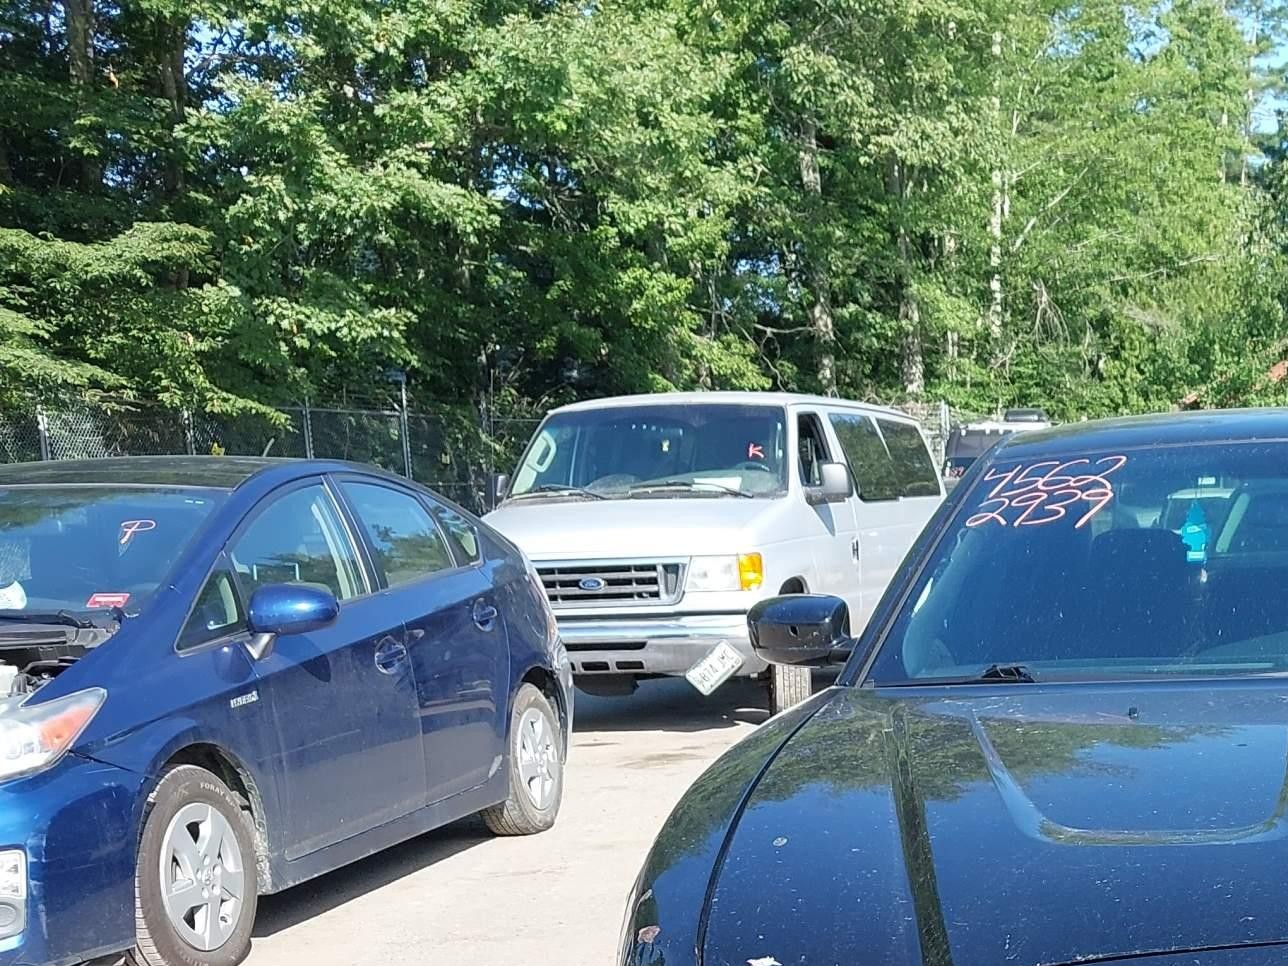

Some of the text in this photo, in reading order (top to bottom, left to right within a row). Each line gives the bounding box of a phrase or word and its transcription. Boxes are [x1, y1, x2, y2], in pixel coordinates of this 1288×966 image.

[748, 443, 765, 458] K
[984, 455, 1127, 498] 4562
[966, 489, 1114, 529] 2939
[120, 520, 156, 544] P
